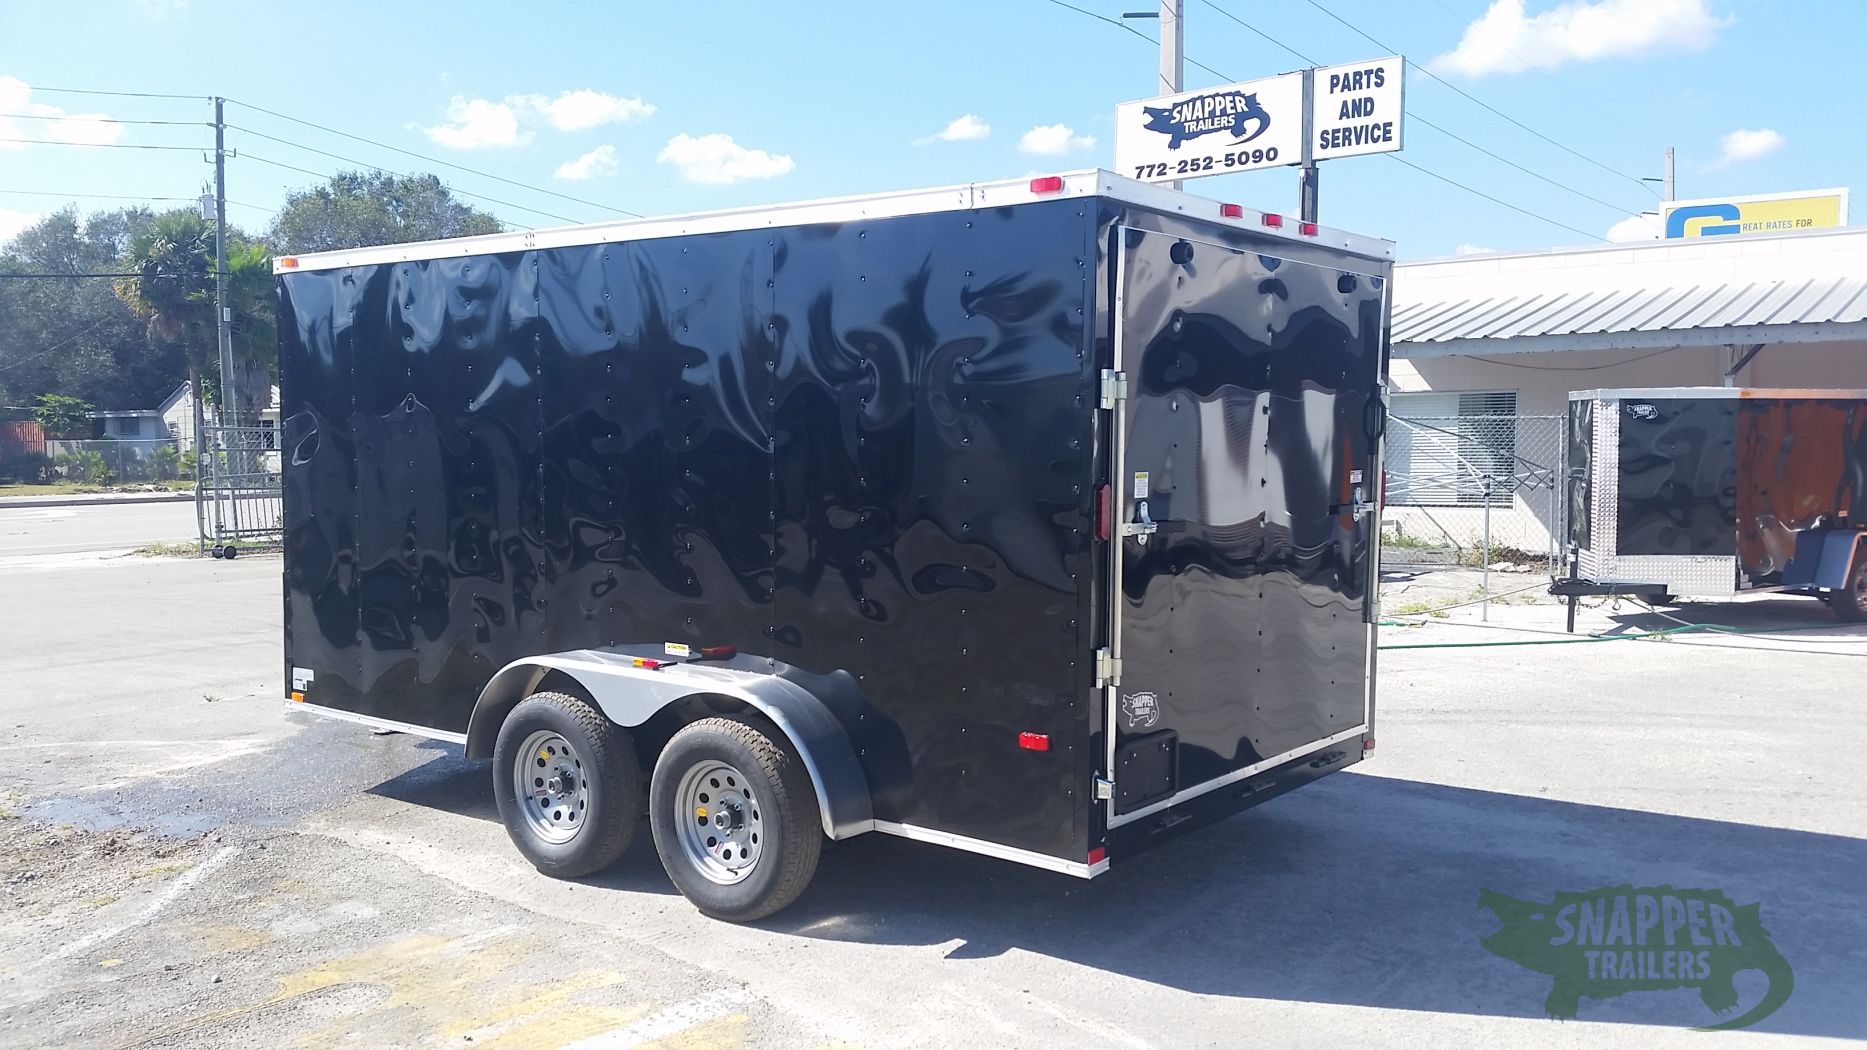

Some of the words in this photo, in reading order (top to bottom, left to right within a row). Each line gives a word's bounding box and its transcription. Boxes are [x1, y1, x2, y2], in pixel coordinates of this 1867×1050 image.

[1329, 67, 1385, 94] PARTS
[1170, 95, 1249, 124] SNAPPER
[1338, 97, 1375, 120] AND
[1183, 115, 1236, 133] TRAILERS
[1319, 122, 1393, 149] SERVICE
[1135, 147, 1279, 179] 772-252-5090
[1766, 220, 1793, 230] RATES
[1796, 218, 1813, 228] FOR
[1131, 695, 1154, 708] SNAPPER
